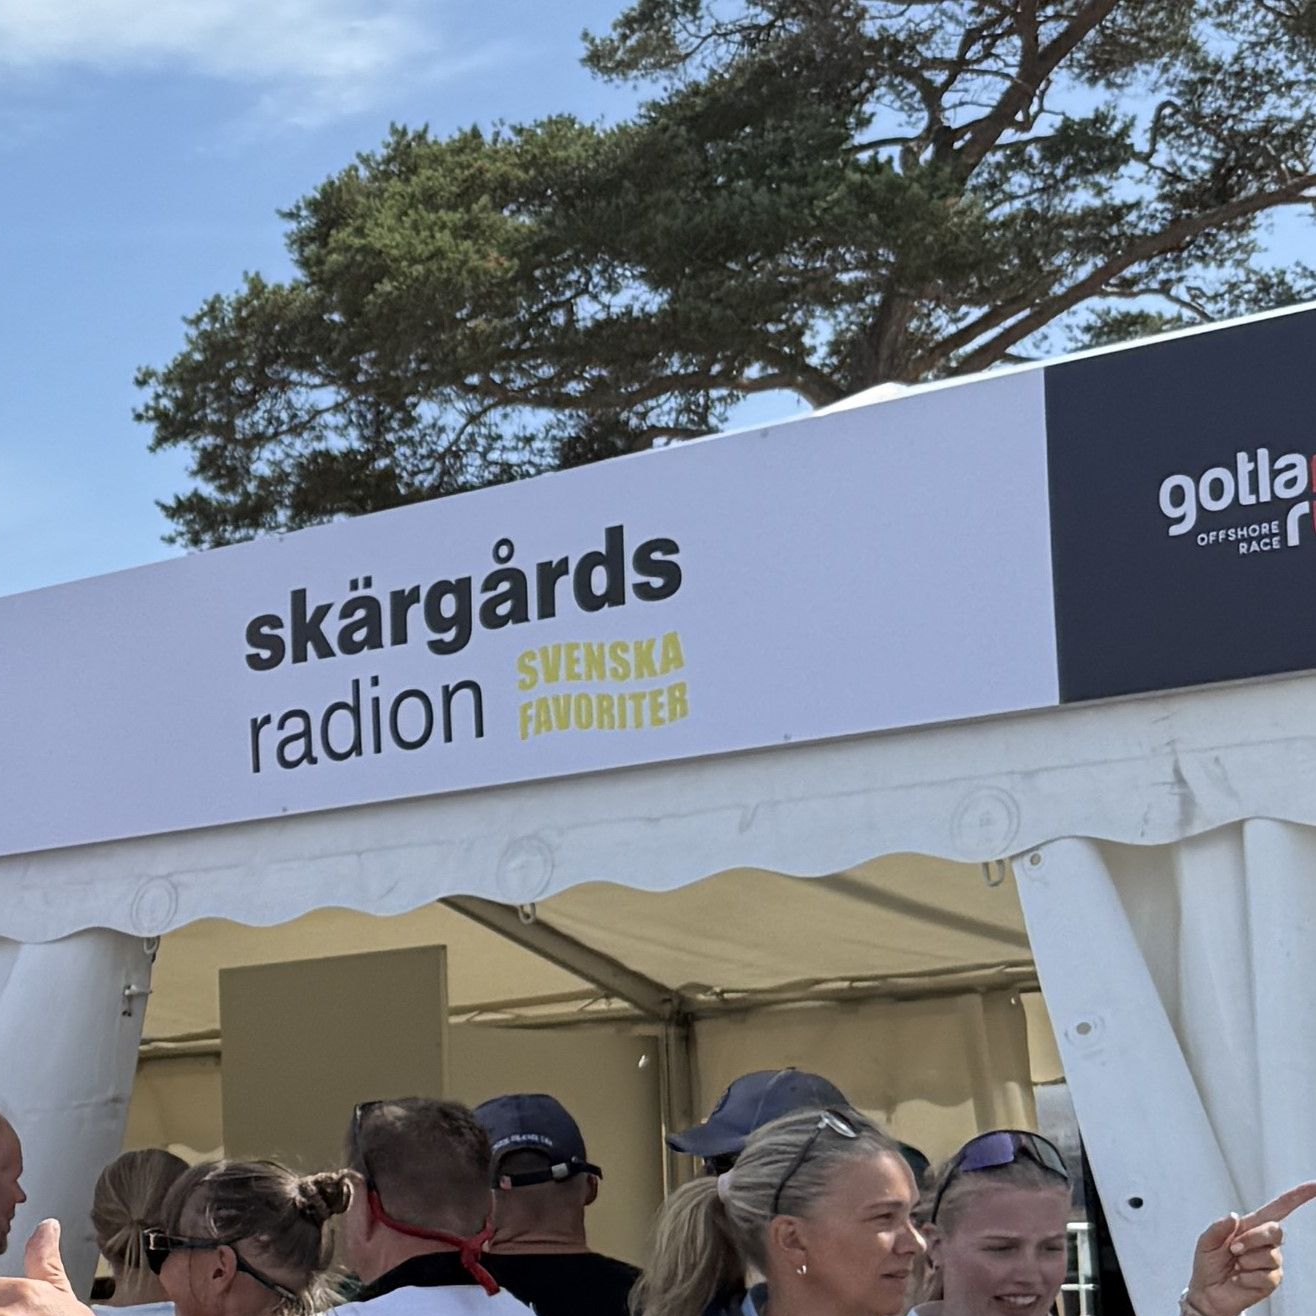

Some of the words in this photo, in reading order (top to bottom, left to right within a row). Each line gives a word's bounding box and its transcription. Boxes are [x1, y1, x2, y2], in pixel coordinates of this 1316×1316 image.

[1159, 447, 1314, 537] gotla
[1197, 520, 1280, 546] OFFSHORE
[1239, 536, 1281, 555] RACE
[244, 524, 683, 672] skärgårds
[515, 631, 686, 690] SVENSKA
[250, 675, 485, 775] radion
[518, 681, 690, 740] FAVORITER
